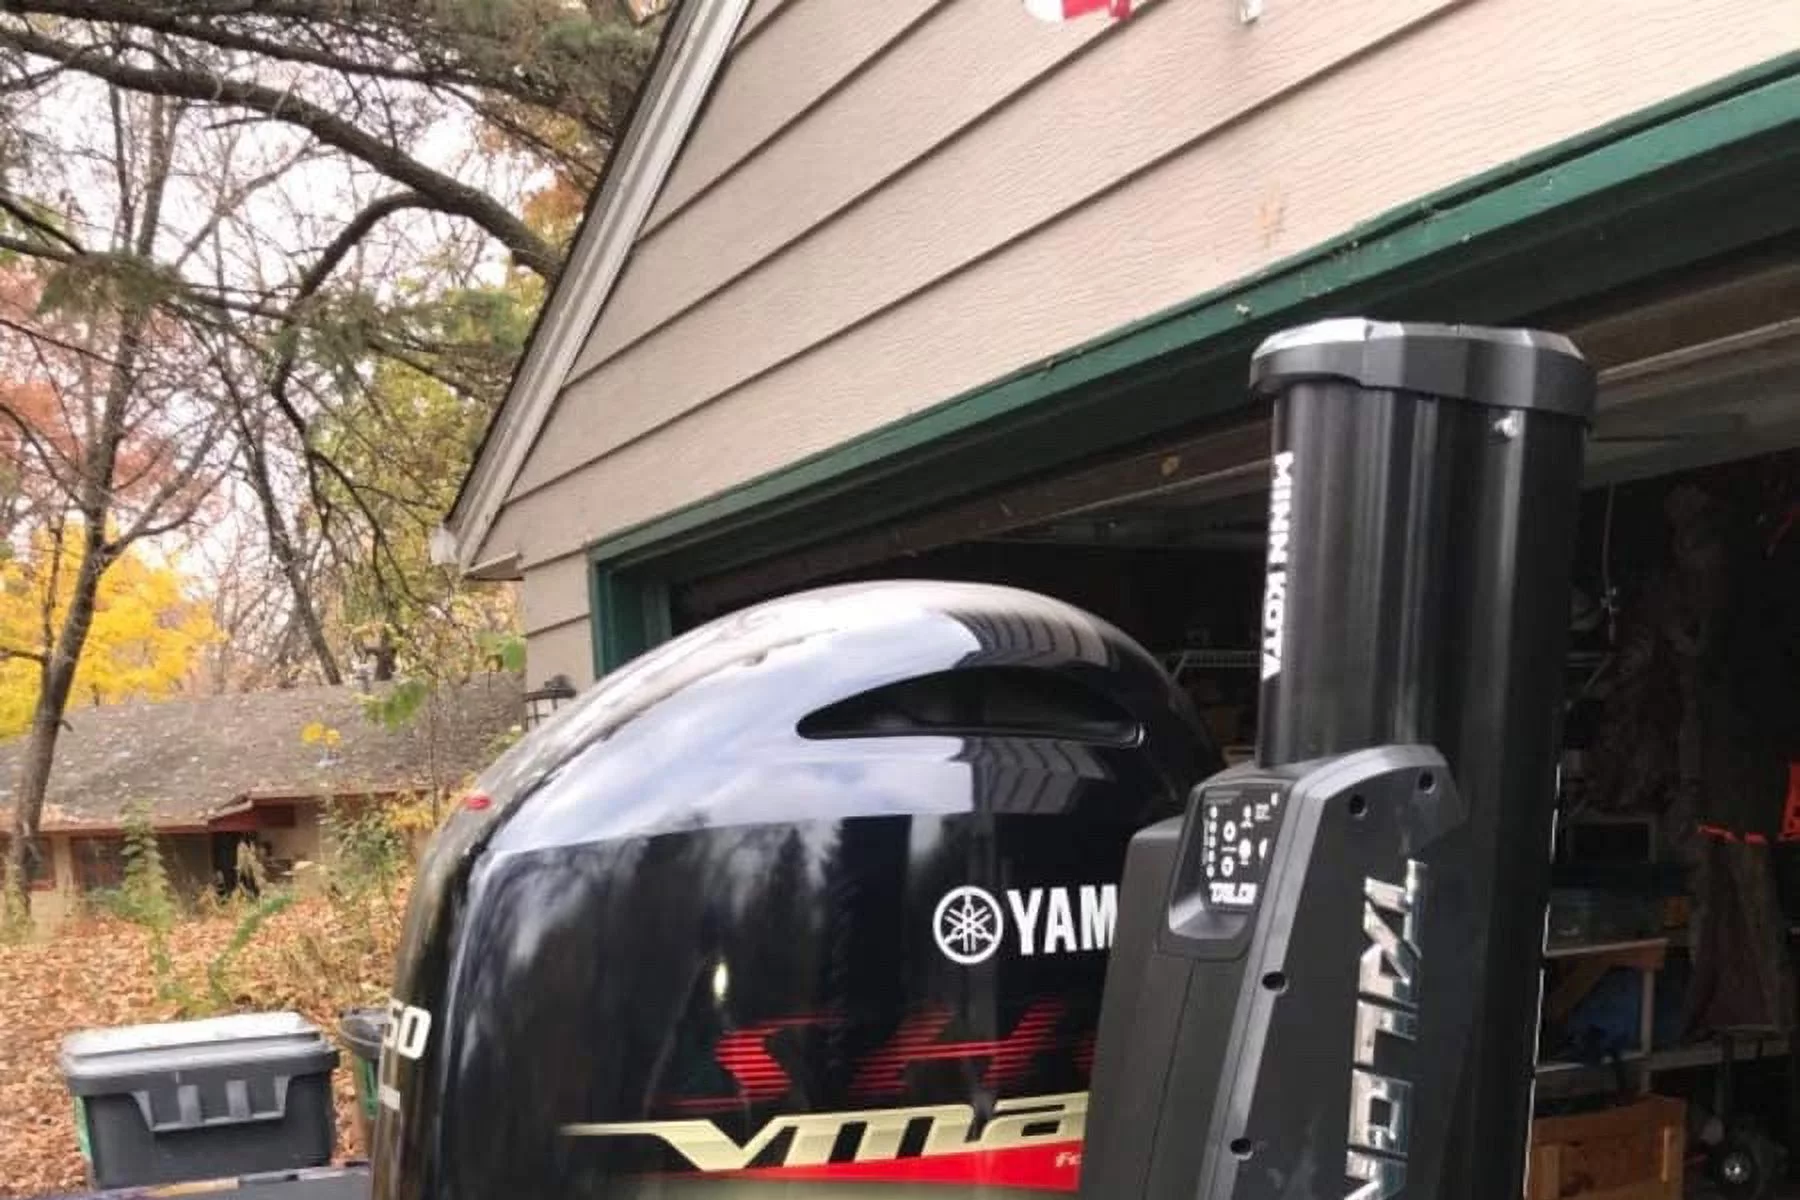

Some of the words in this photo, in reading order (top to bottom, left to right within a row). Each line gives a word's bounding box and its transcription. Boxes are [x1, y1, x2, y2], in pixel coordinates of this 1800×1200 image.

[1267, 450, 1294, 564] MINN
[1260, 570, 1287, 682] KOTA
[1005, 883, 1118, 956] YAM
[655, 996, 1095, 1108] SH
